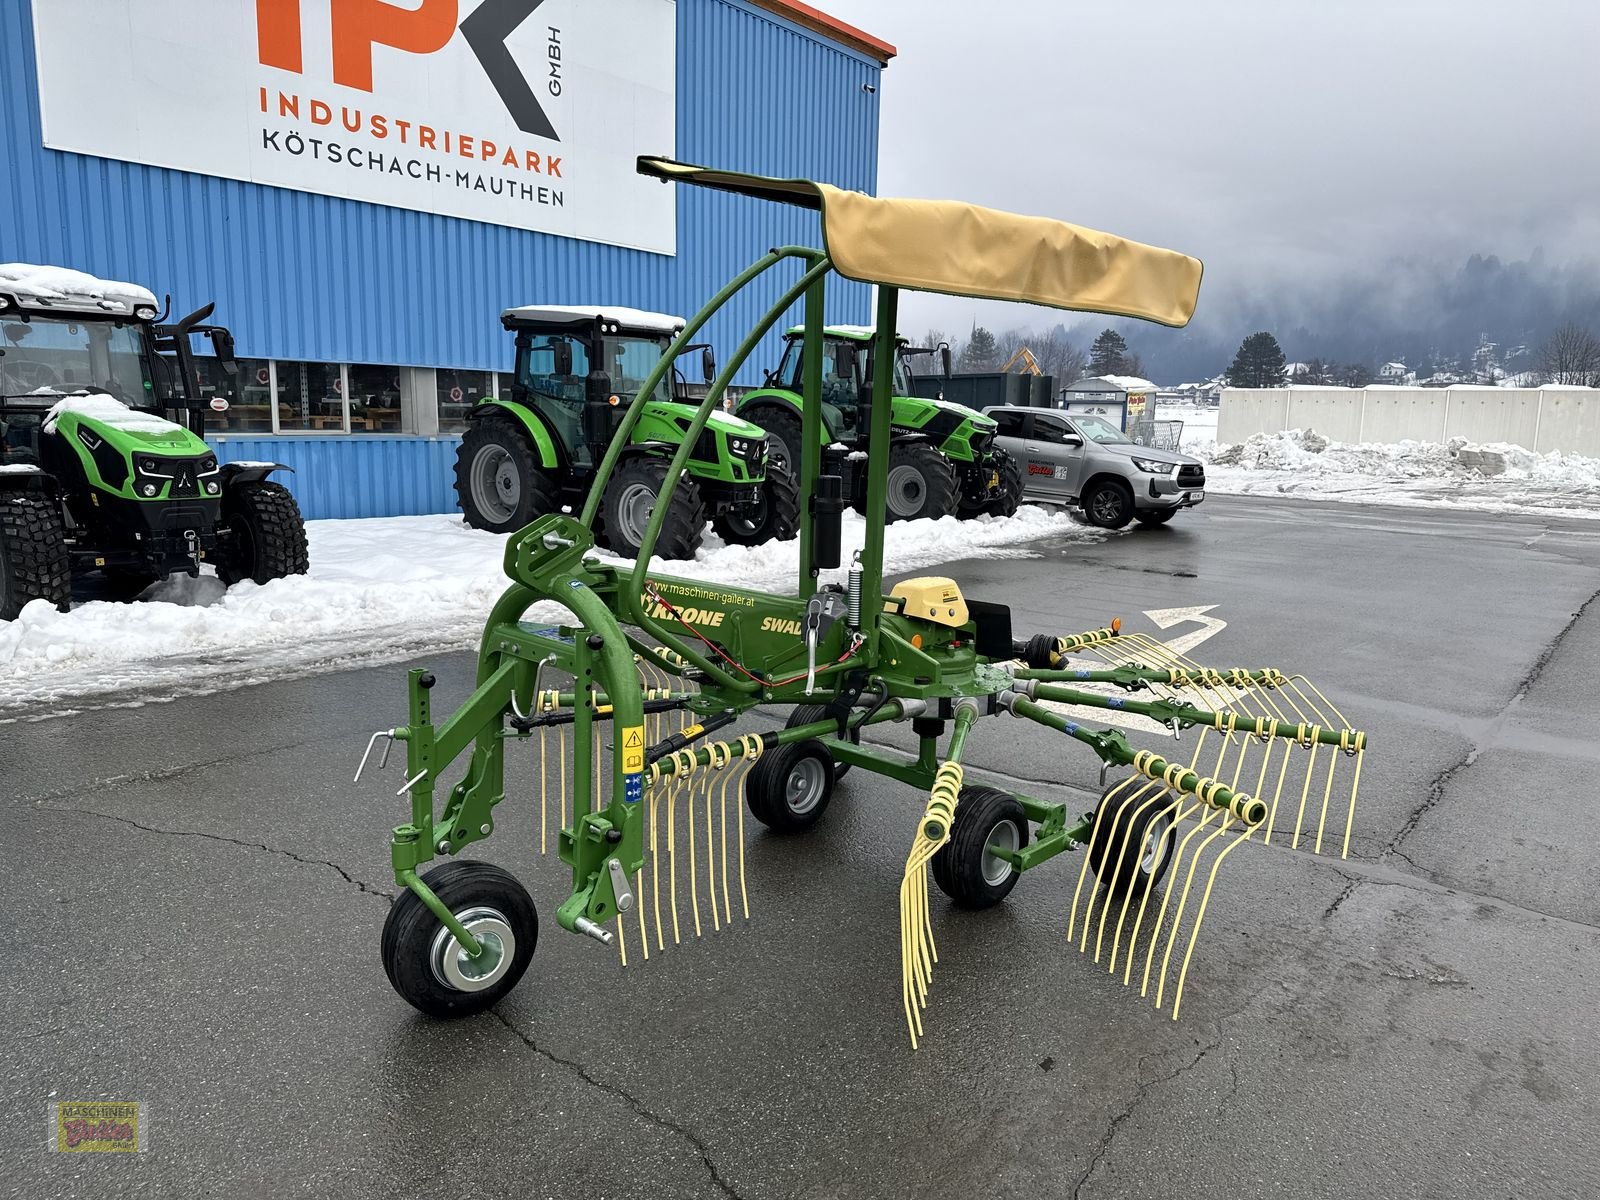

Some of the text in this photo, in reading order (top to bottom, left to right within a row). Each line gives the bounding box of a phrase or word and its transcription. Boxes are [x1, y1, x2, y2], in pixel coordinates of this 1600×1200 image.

[548, 26, 562, 97] GMBH
[259, 86, 562, 178] INDUSTRIEPARK
[262, 127, 564, 207] KÖTSCHACH-MAUTHEN
[651, 603, 726, 627] KRONE
[652, 582, 755, 608] ww.maschinen-gailer.at
